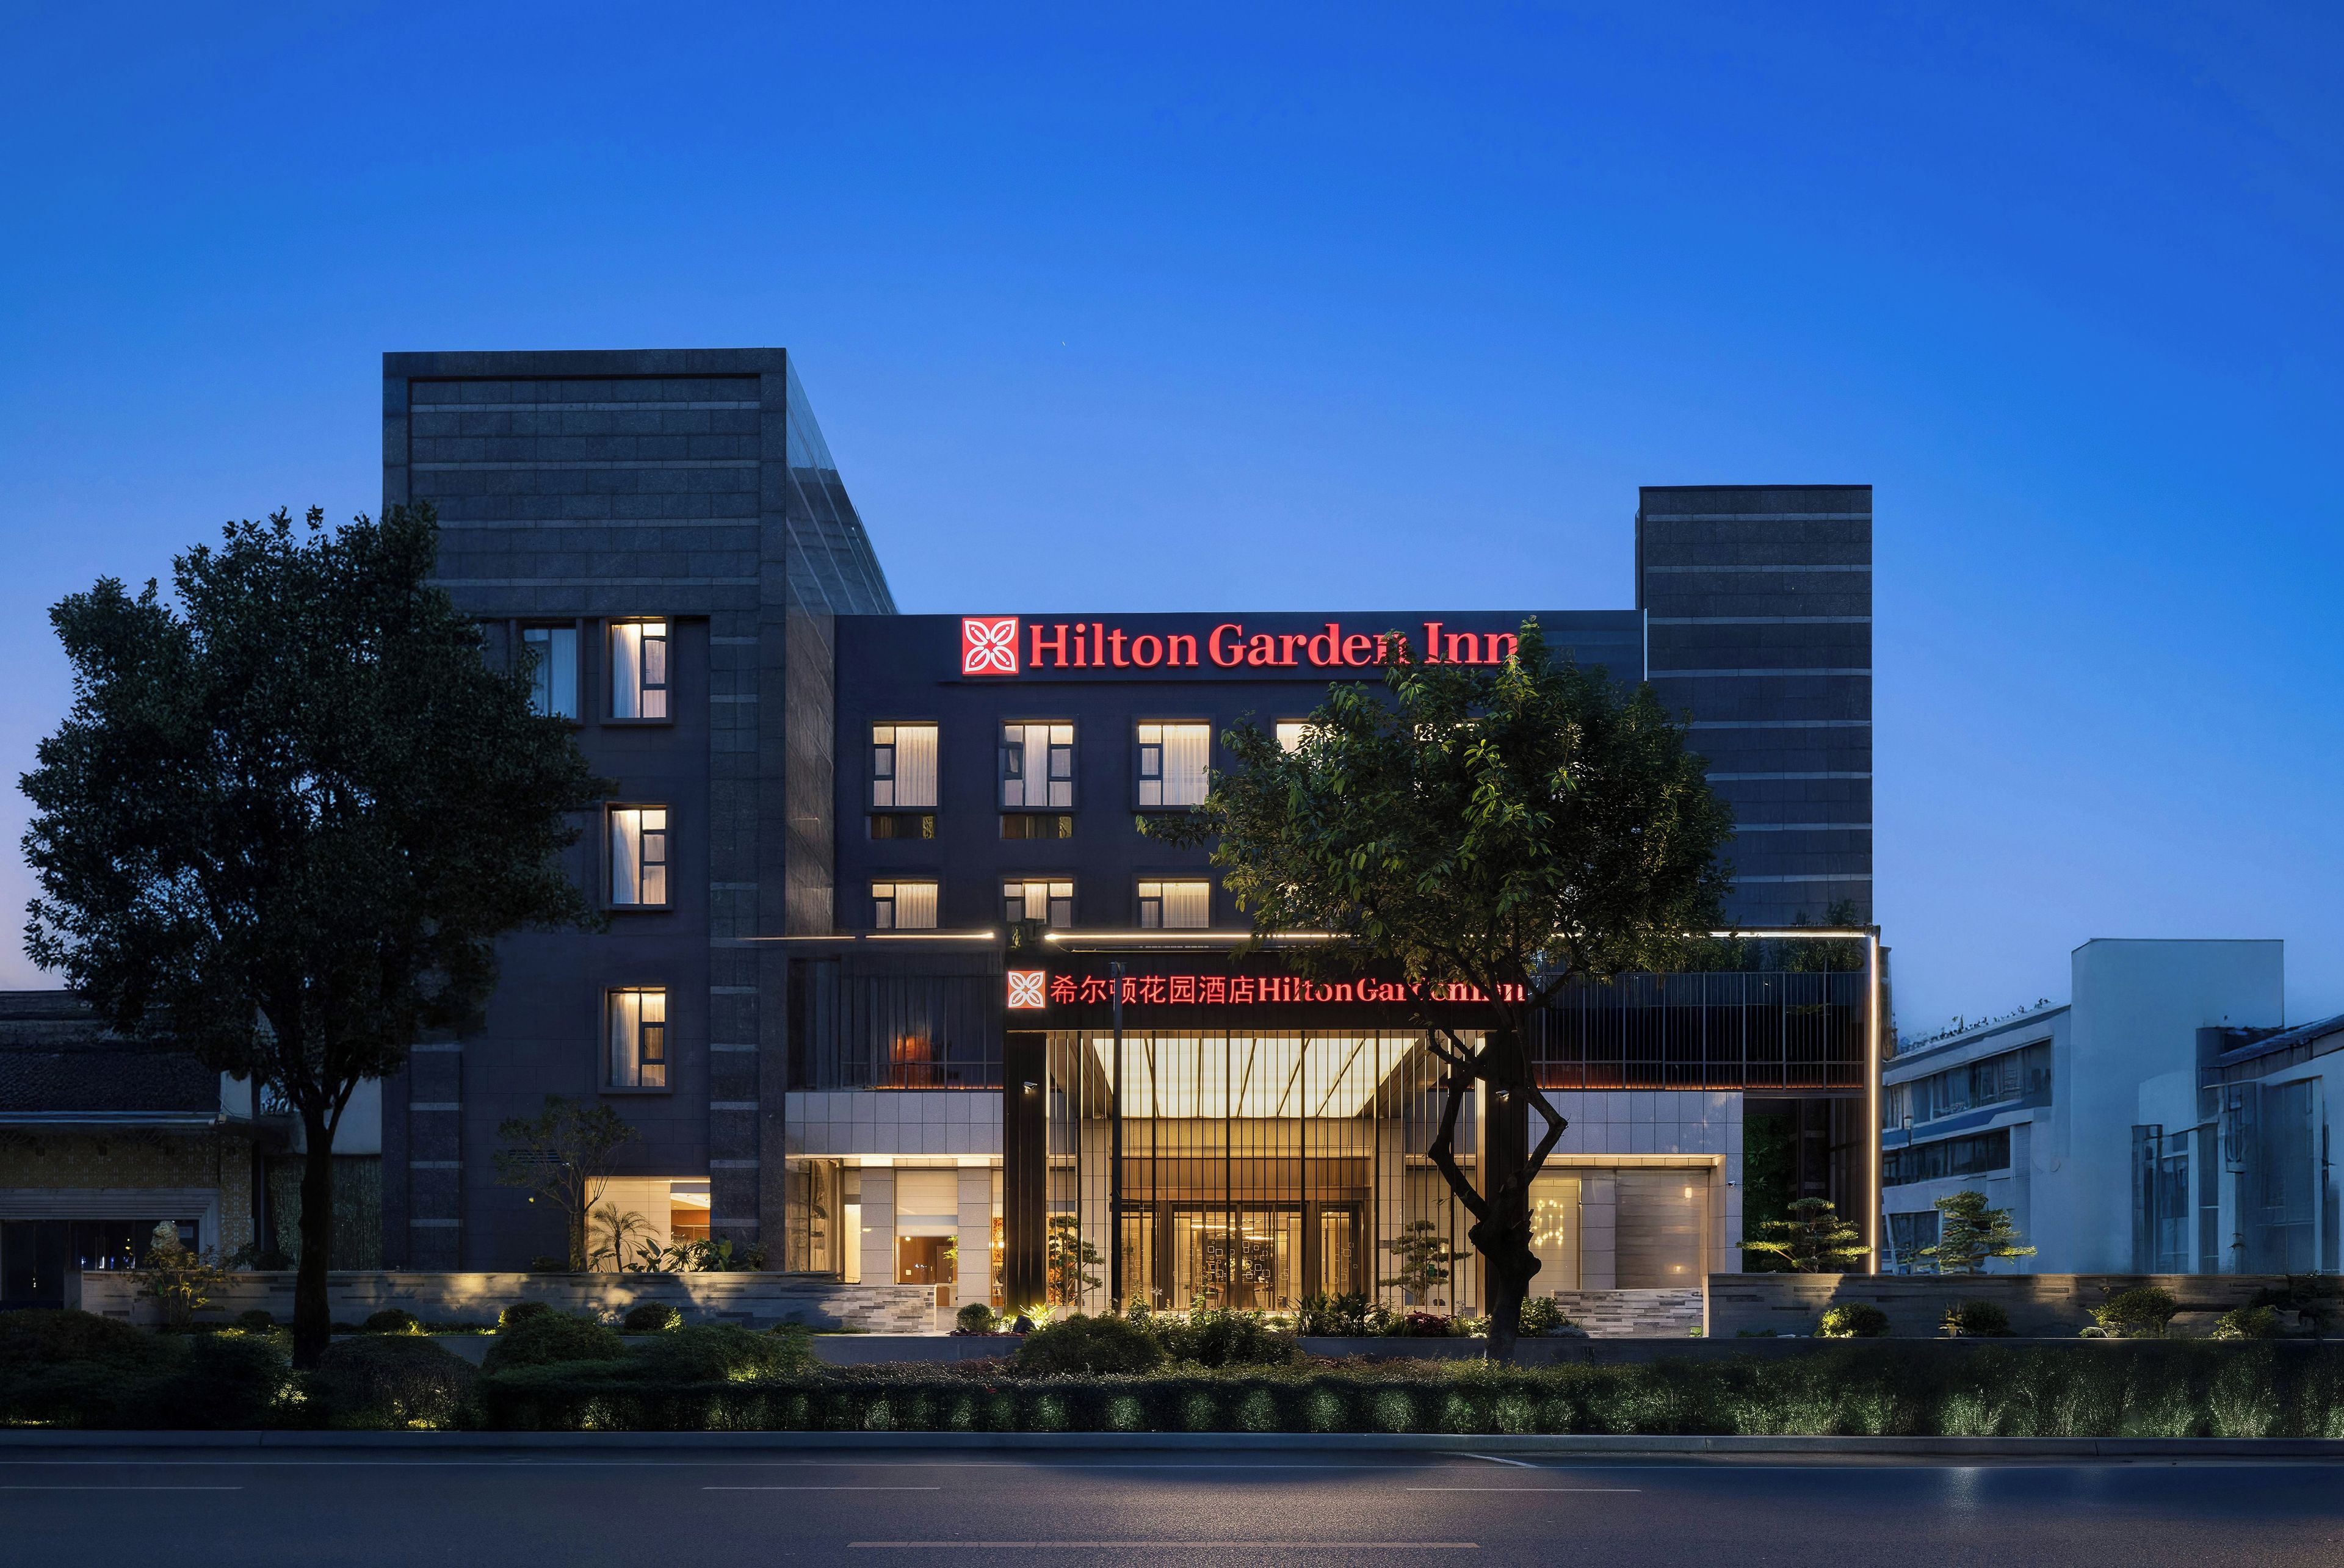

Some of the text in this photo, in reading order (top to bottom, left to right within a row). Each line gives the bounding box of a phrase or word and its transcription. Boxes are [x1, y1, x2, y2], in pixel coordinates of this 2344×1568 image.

[1029, 623, 1198, 666] Hilton
[1424, 623, 1519, 663] Inn
[1050, 975, 1254, 1003] 希尔顿花园酒店
